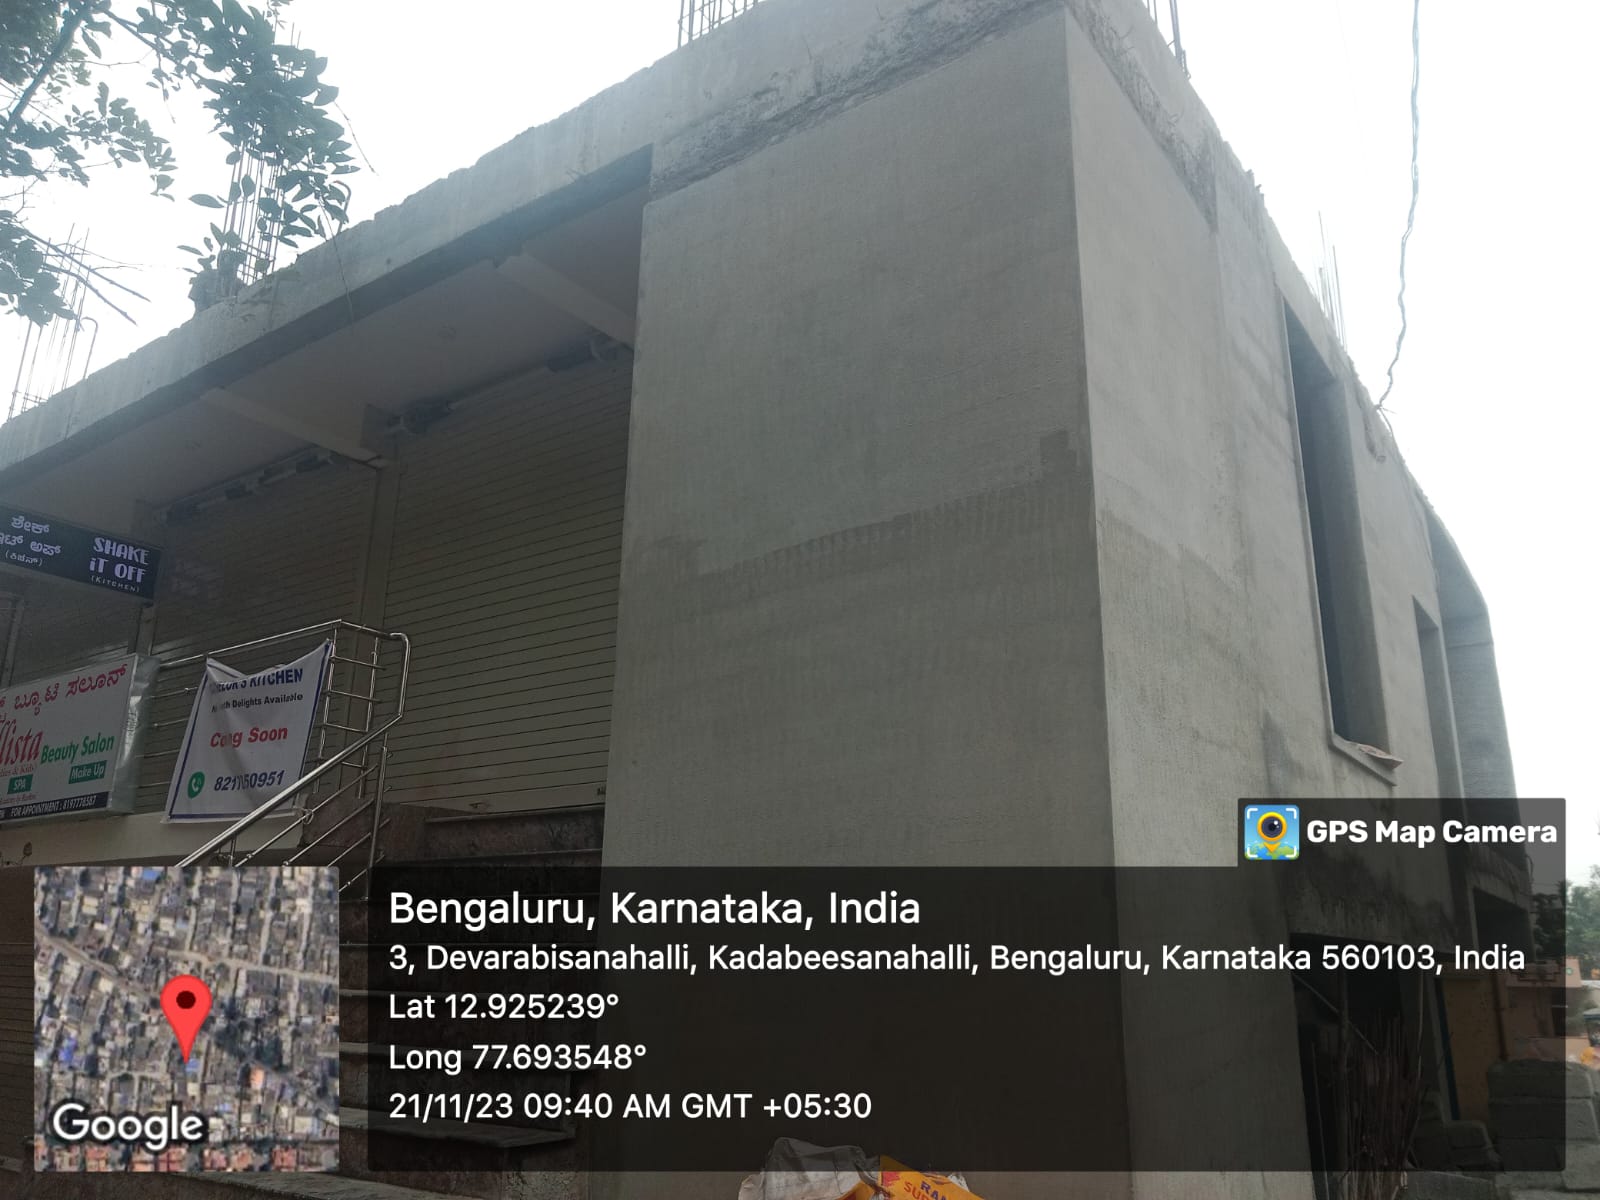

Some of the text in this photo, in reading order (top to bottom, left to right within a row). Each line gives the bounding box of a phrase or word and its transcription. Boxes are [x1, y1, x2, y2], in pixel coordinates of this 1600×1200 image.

[93, 537, 150, 565] SHAKE
[114, 563, 147, 583] OFF
[232, 697, 262, 709] Delights
[264, 692, 304, 705] Available
[248, 726, 288, 744] Soon
[40, 742, 80, 765] Beauty
[81, 732, 115, 757] Salon
[71, 763, 105, 780] Make Up
[11, 806, 22, 817] FOR
